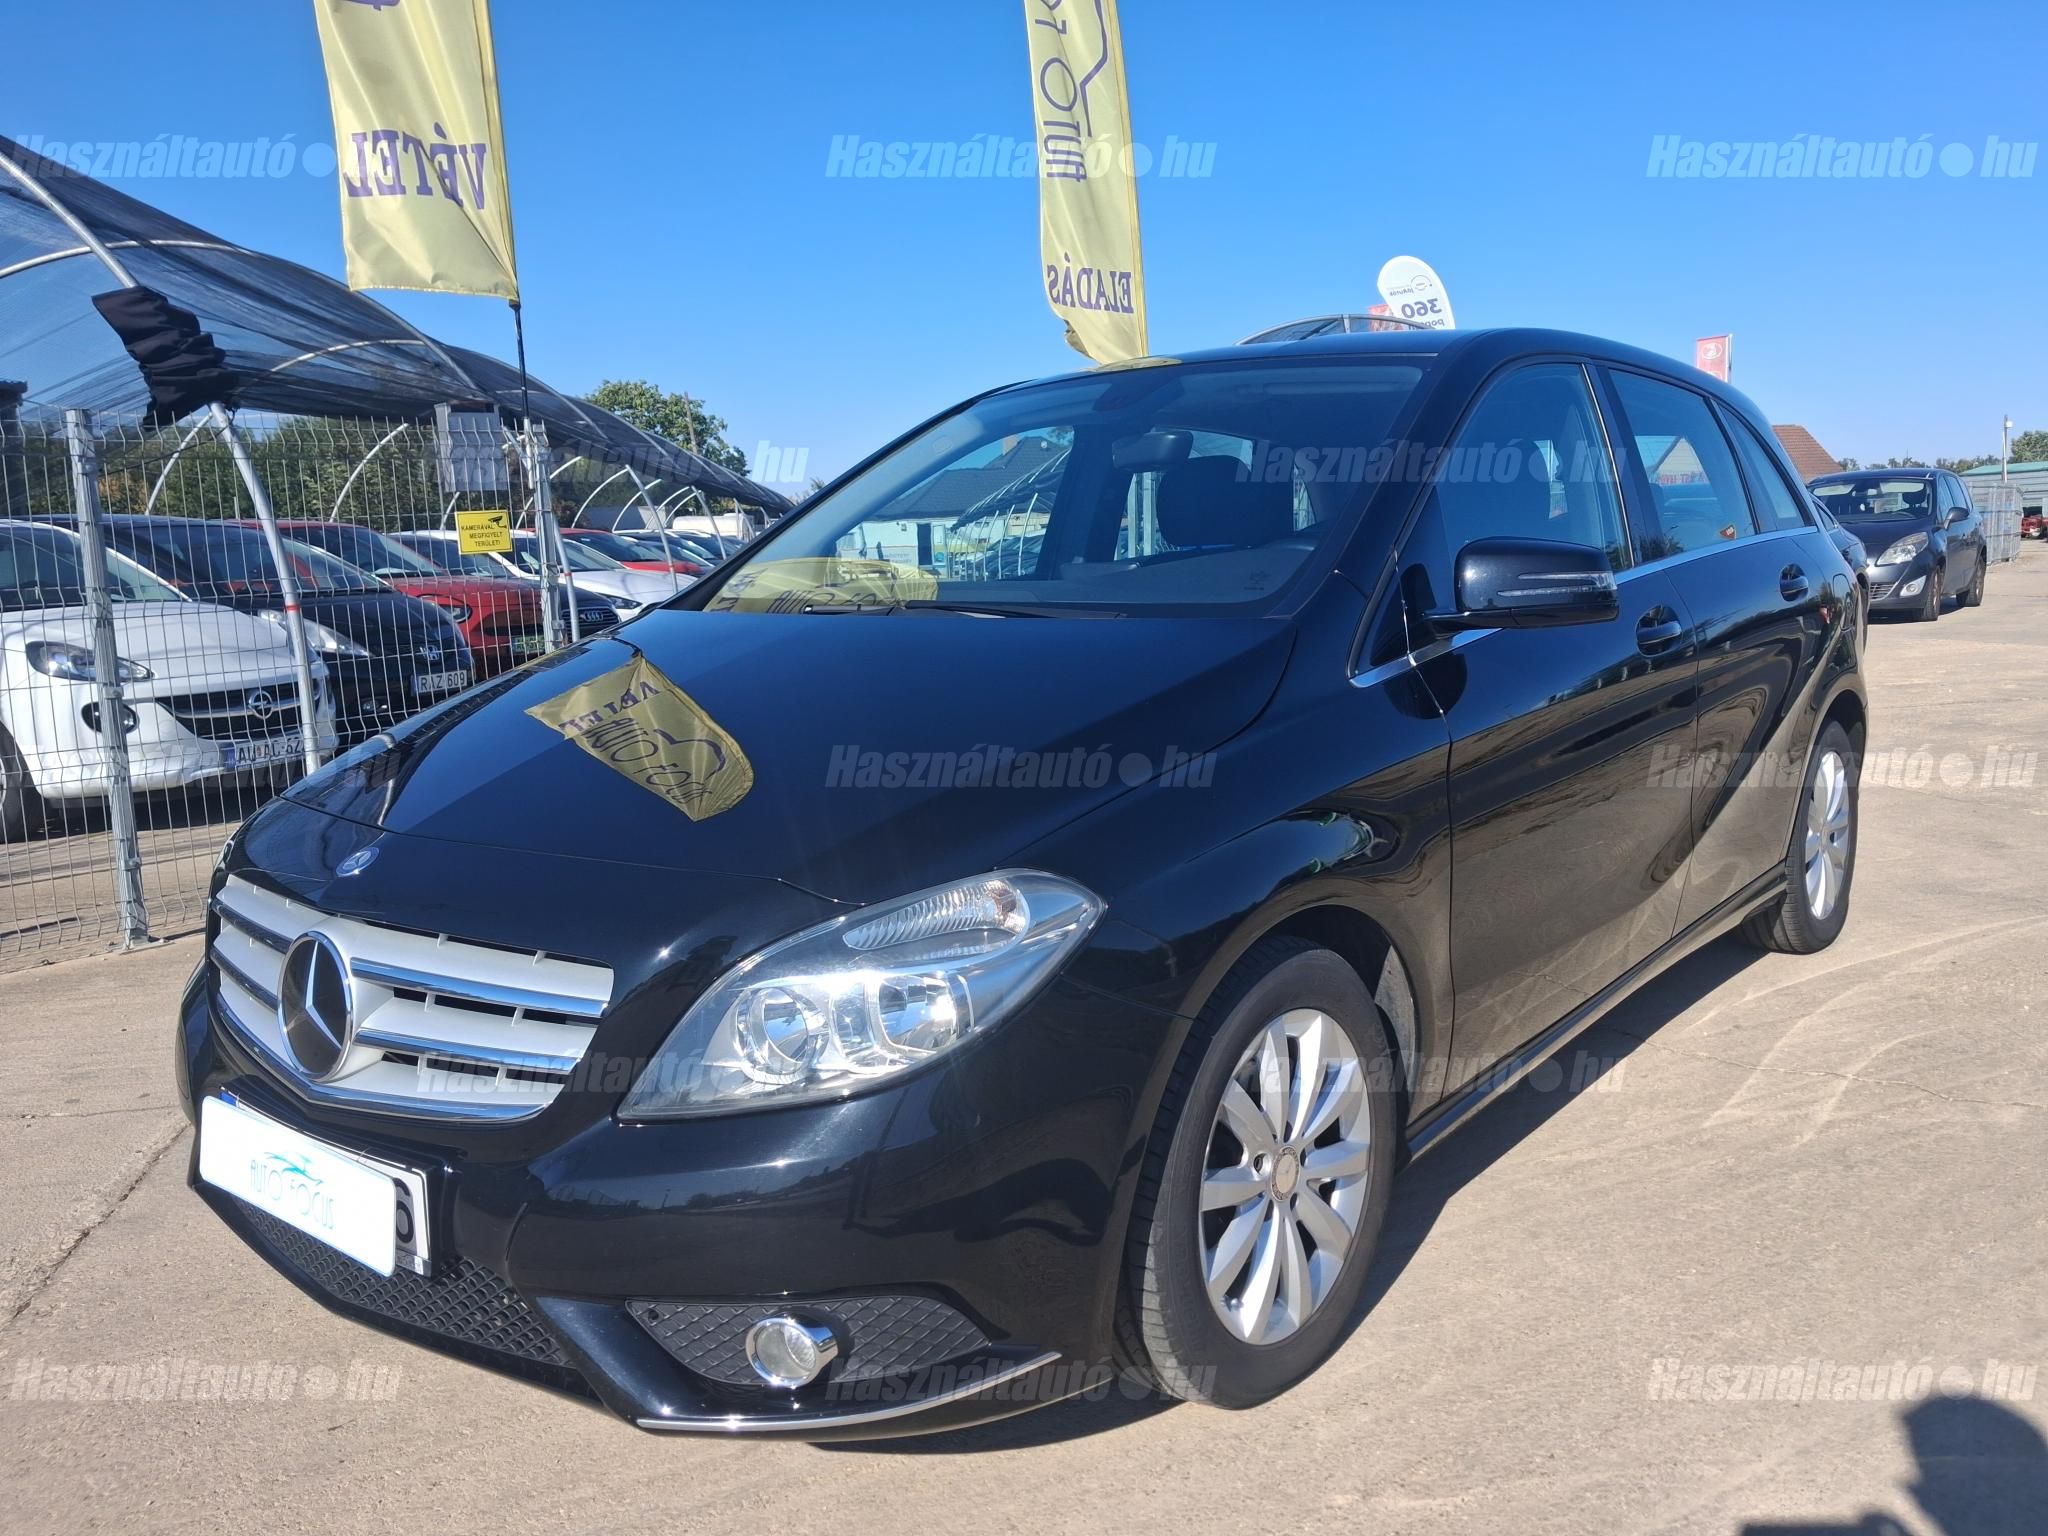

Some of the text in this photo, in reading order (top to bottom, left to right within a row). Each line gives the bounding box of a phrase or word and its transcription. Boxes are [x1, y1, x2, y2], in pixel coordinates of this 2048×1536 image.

[469, 531, 503, 539] MEGFIGYELT
[420, 671, 465, 692] RAZ 609
